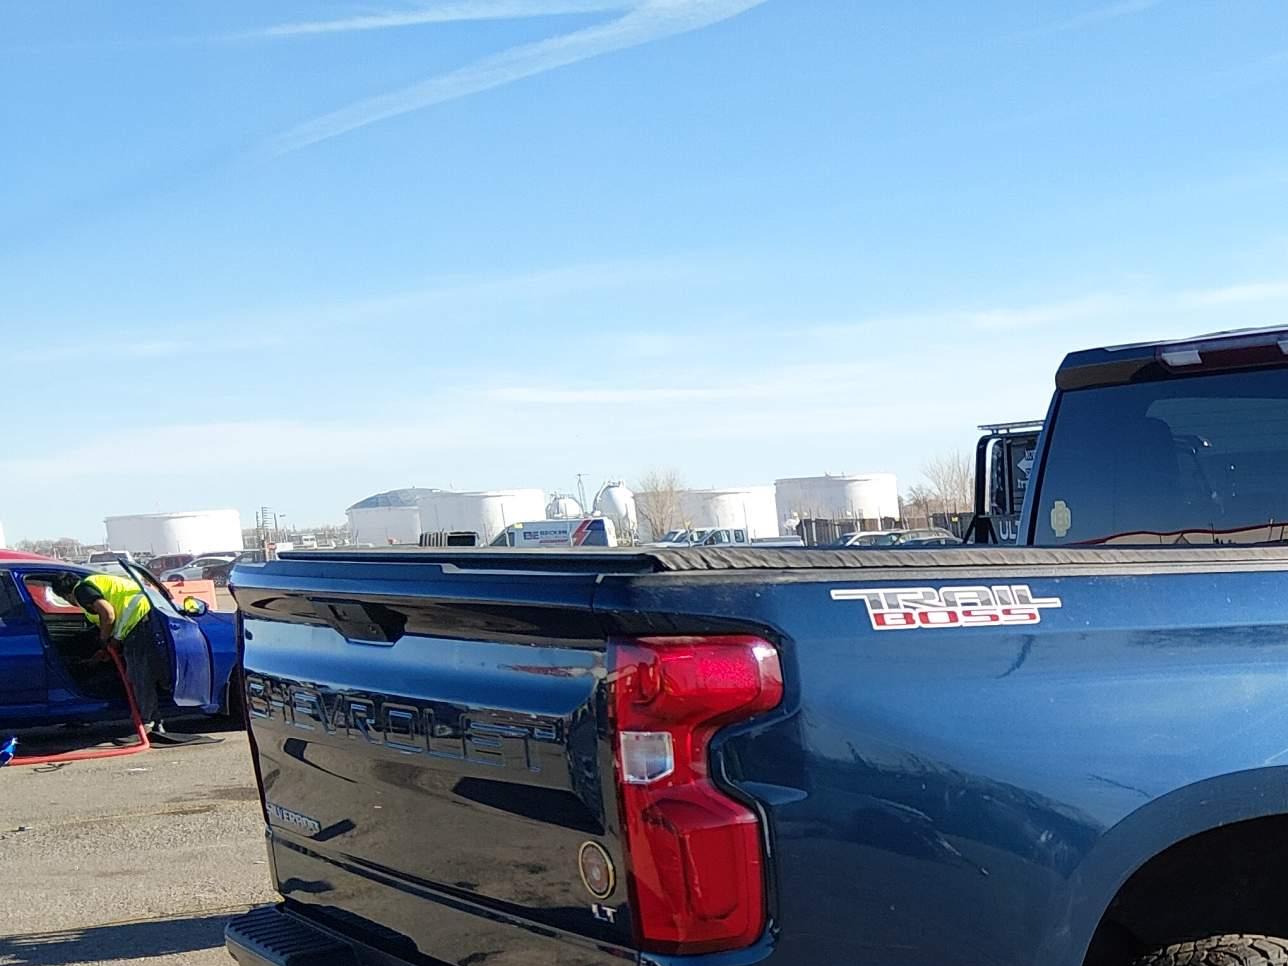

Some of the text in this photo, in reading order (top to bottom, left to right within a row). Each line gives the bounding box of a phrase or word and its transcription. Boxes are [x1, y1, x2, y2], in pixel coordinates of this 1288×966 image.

[831, 585, 1062, 610] TRAIL
[873, 607, 1041, 631] BOSS
[247, 677, 566, 774] CHEVROLET
[266, 802, 321, 834] SILVERADO
[592, 904, 617, 924] LT
